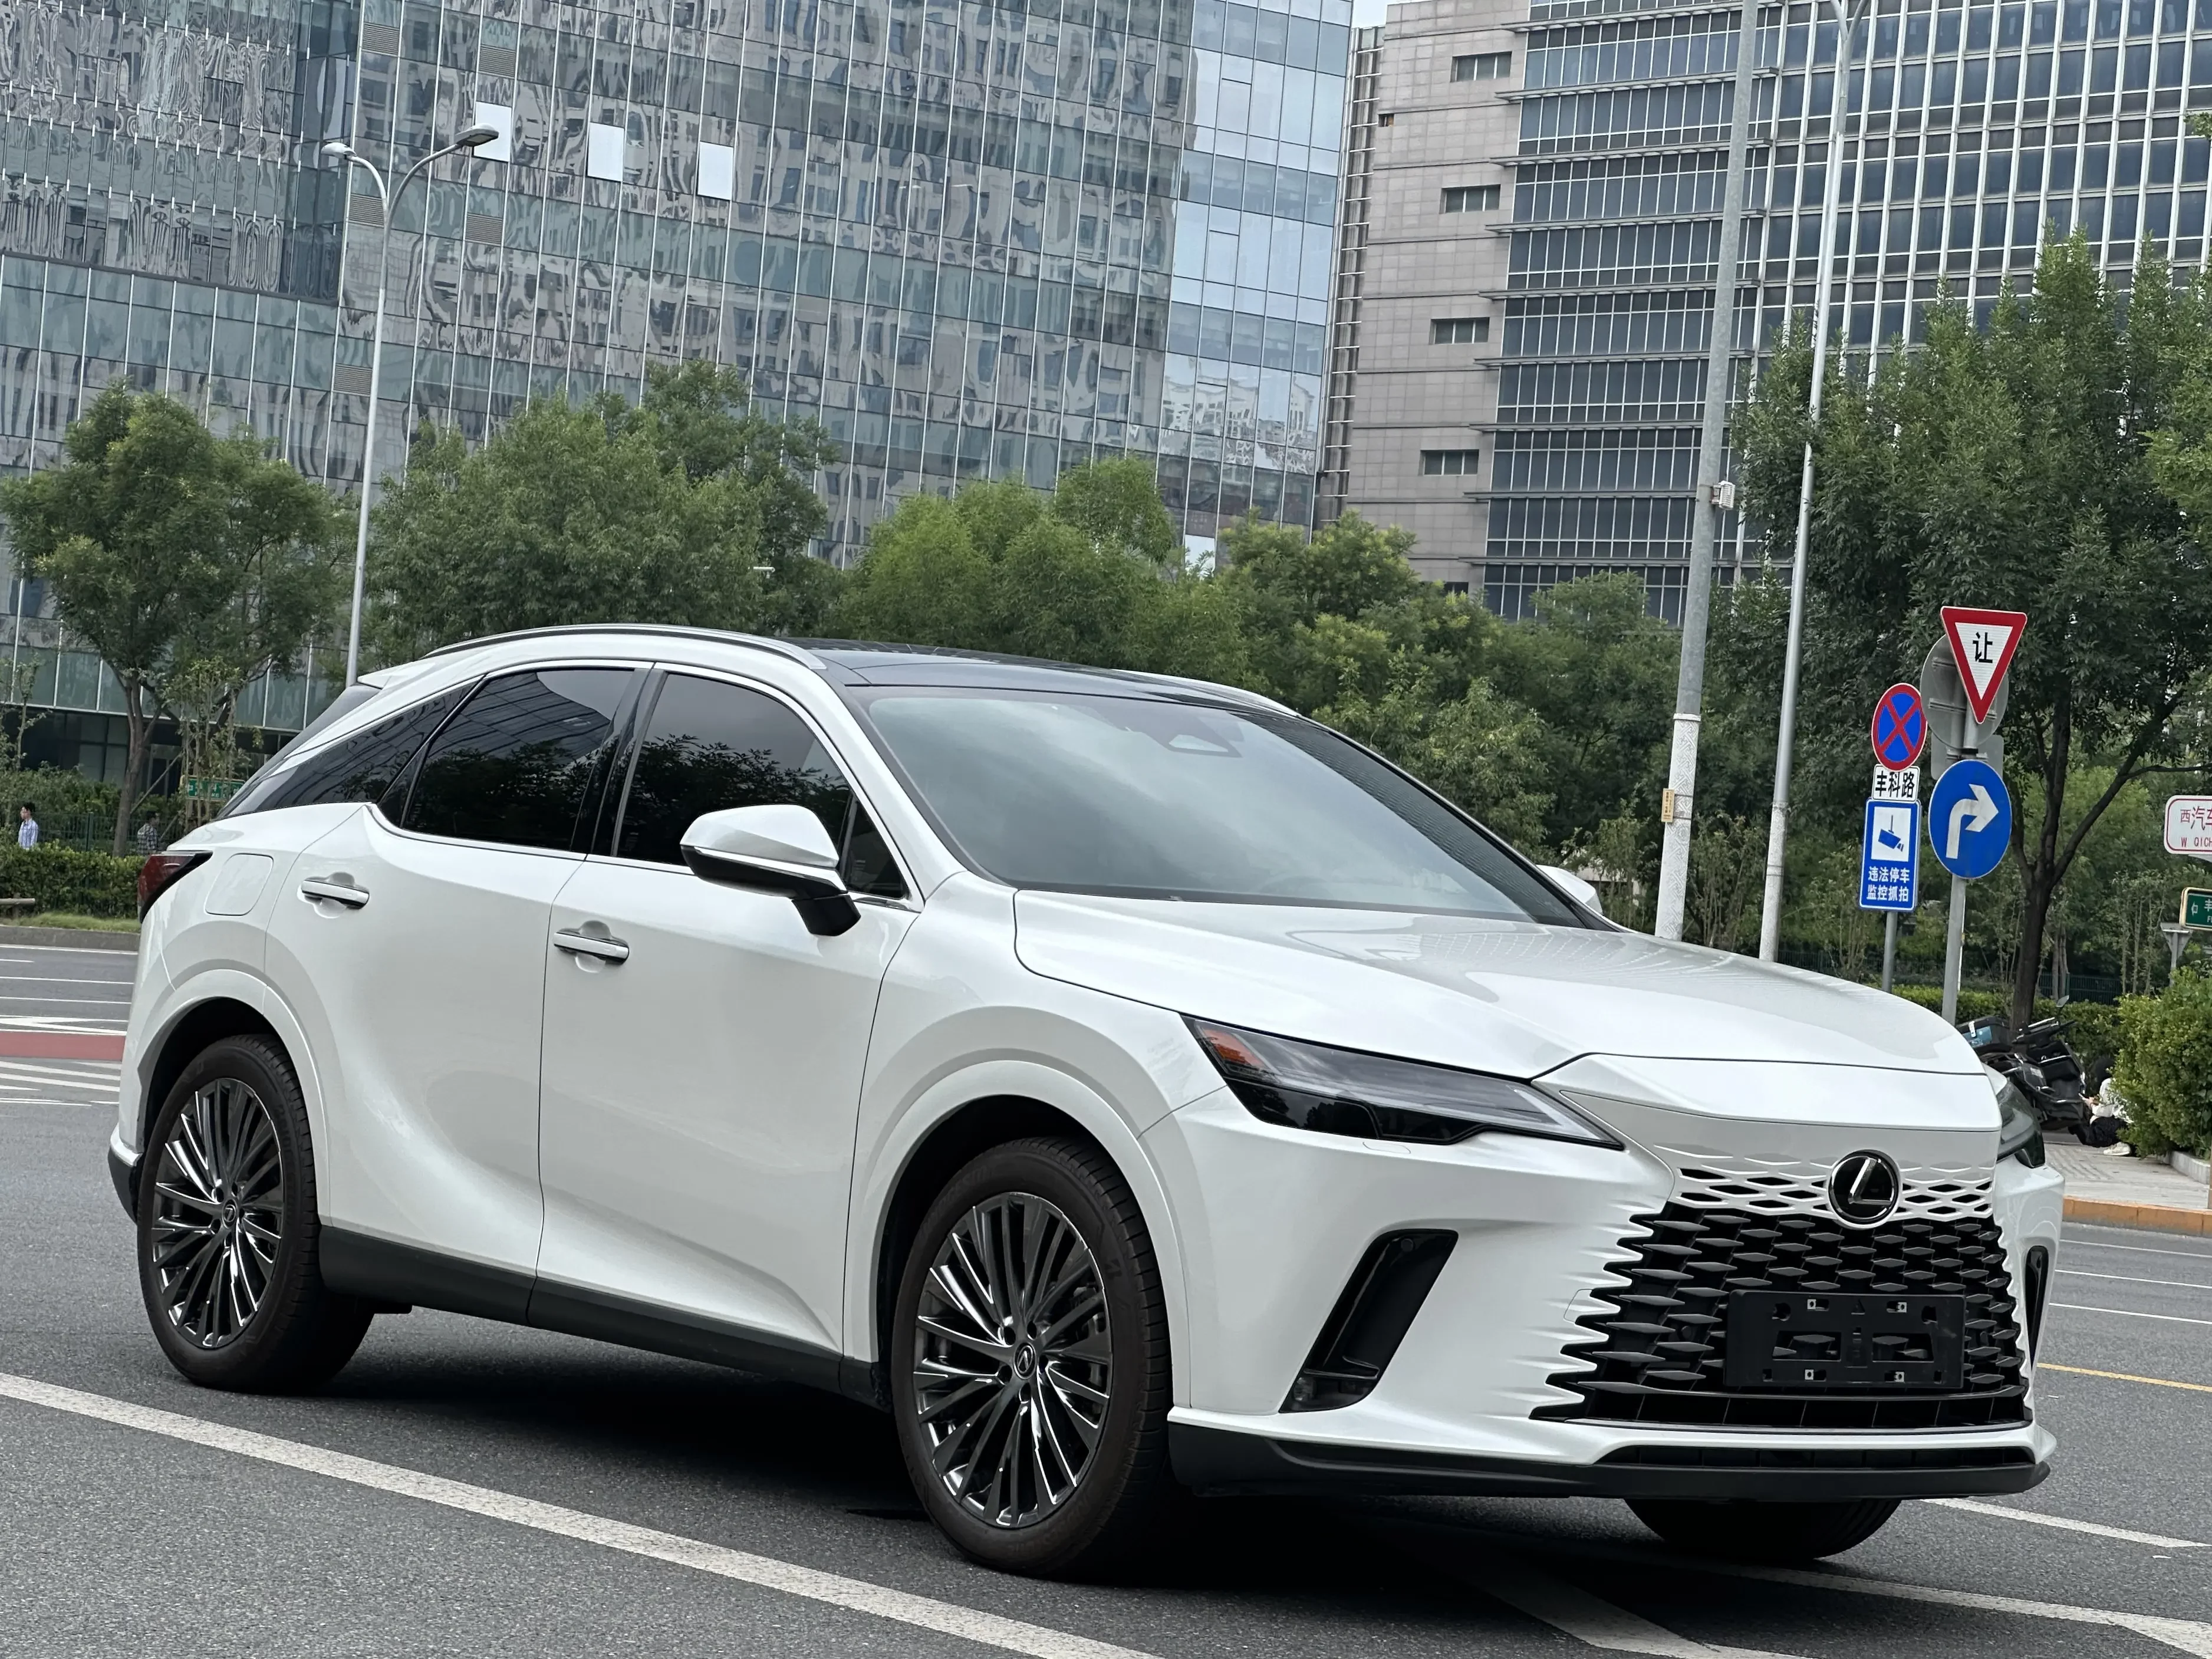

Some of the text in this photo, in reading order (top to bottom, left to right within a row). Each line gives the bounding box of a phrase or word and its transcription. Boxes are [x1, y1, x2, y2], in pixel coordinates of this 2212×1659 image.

[1972, 631, 1993, 663] 让
[1875, 771, 1915, 798] 丰科路
[2181, 837, 2187, 847] W
[1868, 865, 1910, 883] 违法停车
[1867, 884, 1909, 902] 监控抓拍
